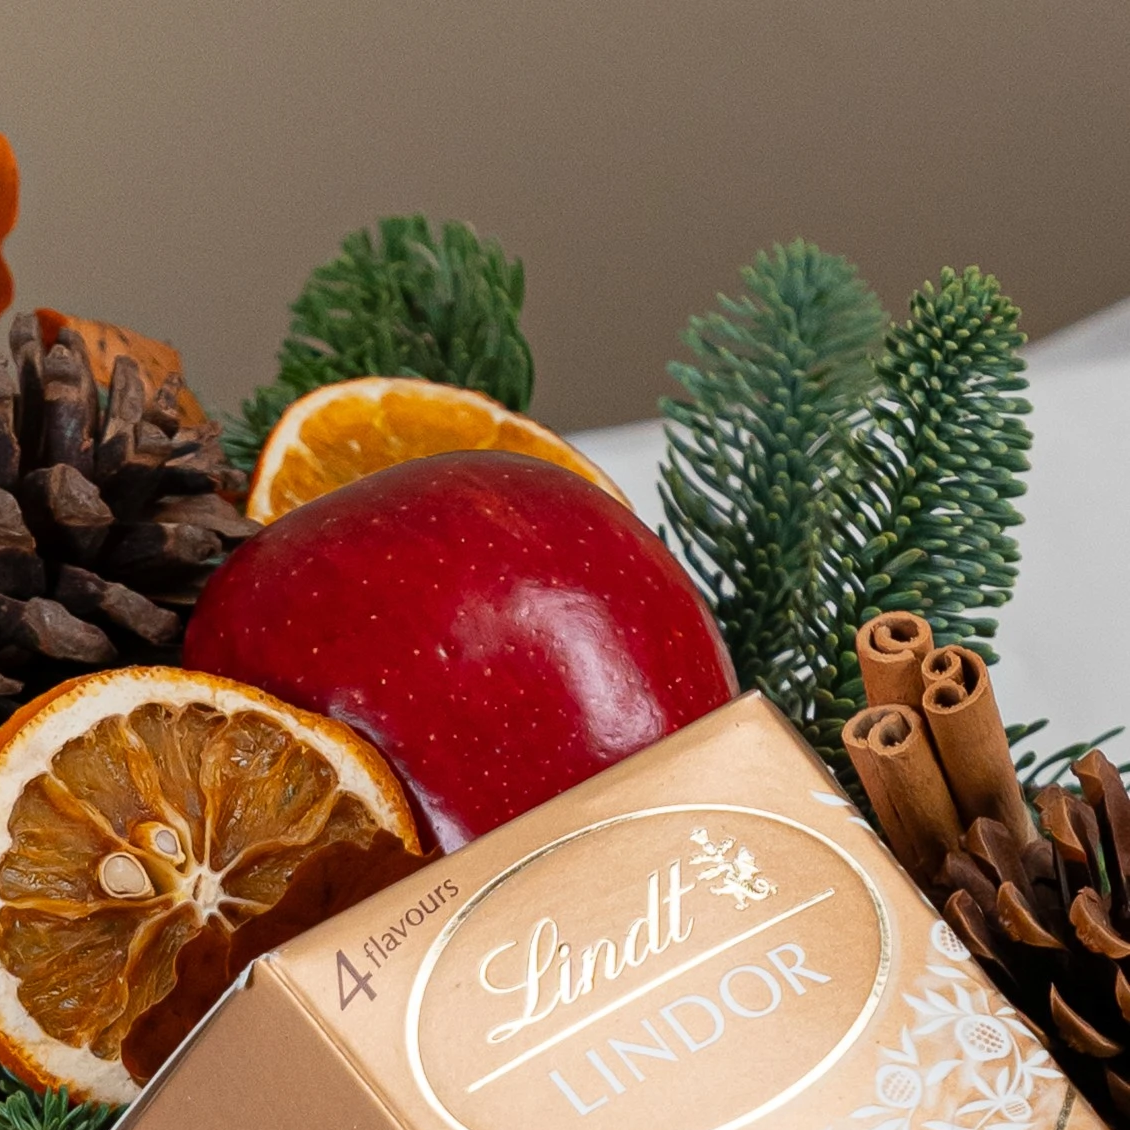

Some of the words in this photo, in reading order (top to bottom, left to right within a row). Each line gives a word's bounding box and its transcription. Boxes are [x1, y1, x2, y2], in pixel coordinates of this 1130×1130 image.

[337, 949, 378, 1012] 4
[365, 878, 460, 970] flavours
[479, 859, 697, 1045] Lindt
[549, 942, 832, 1116] LINDOR
